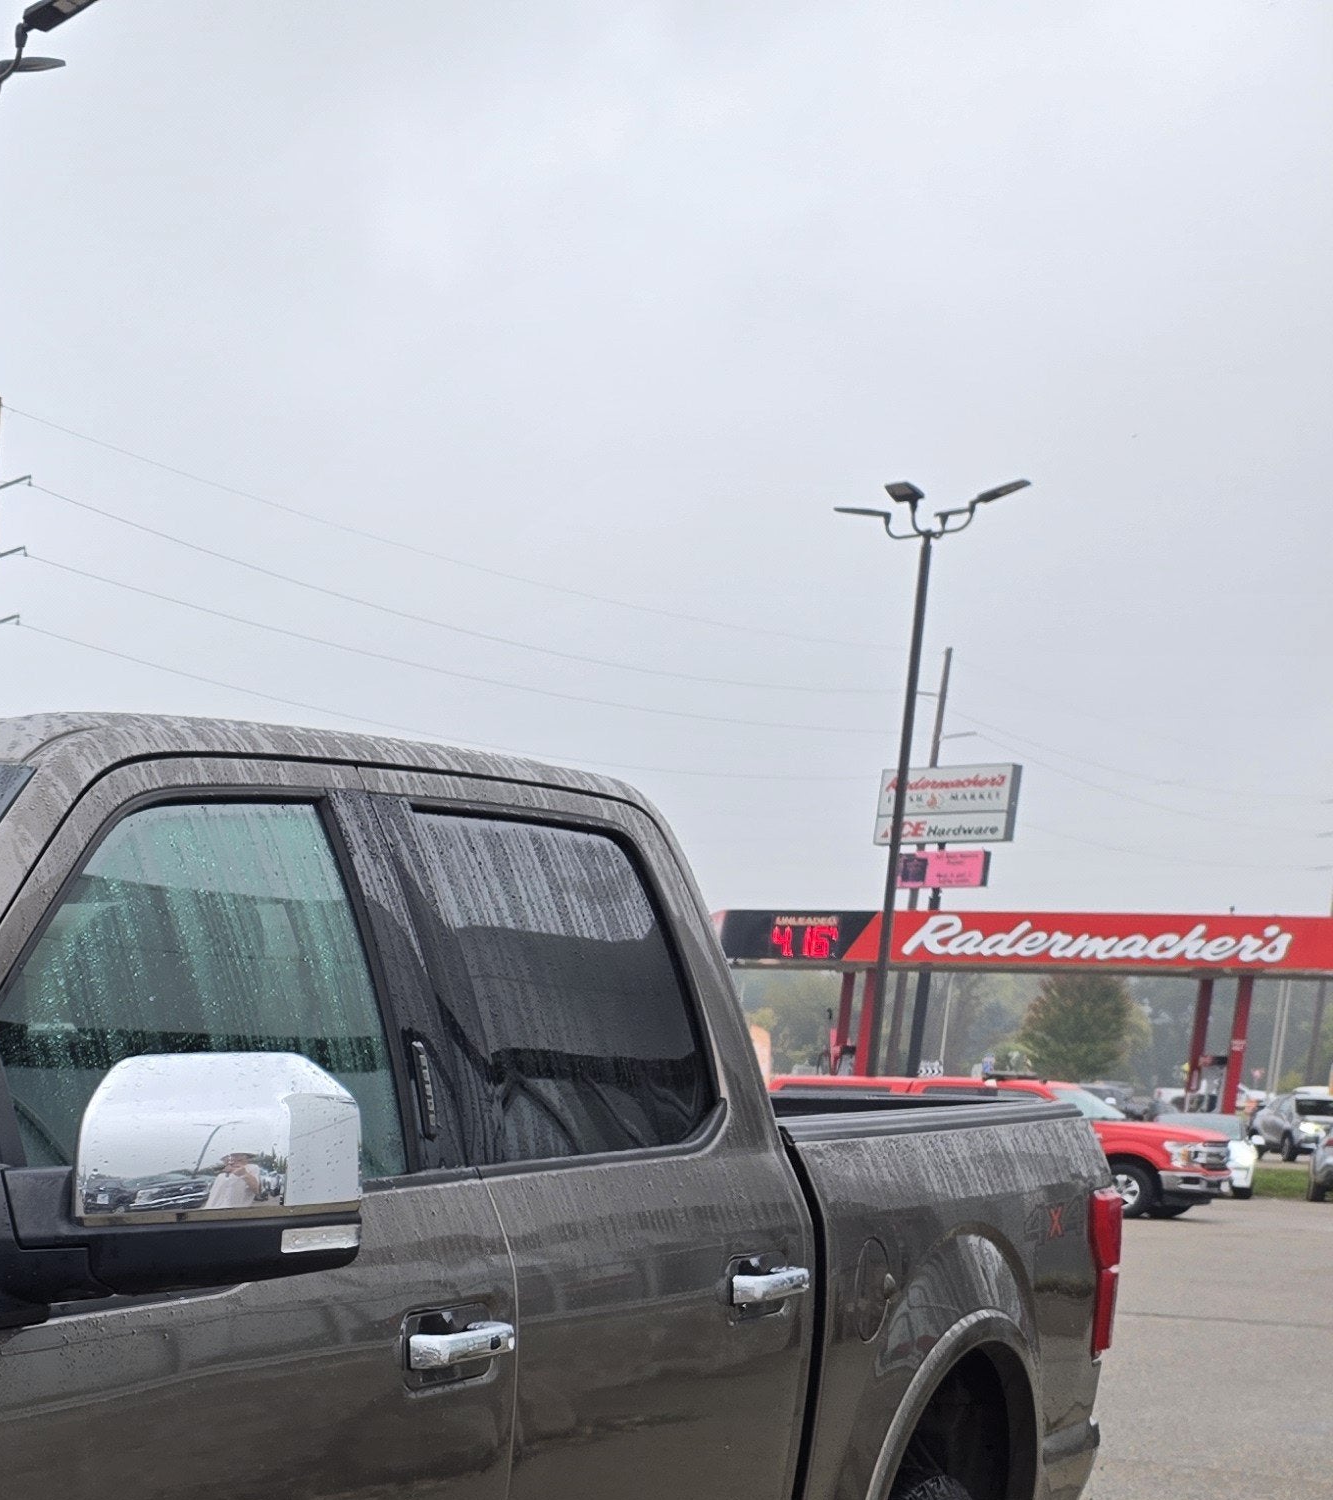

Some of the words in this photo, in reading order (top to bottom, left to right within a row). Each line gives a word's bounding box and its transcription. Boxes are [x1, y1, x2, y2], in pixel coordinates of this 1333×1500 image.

[949, 792, 1000, 800] MARKET
[927, 825, 998, 837] Hardware
[902, 914, 1293, 963] Radermacher's
